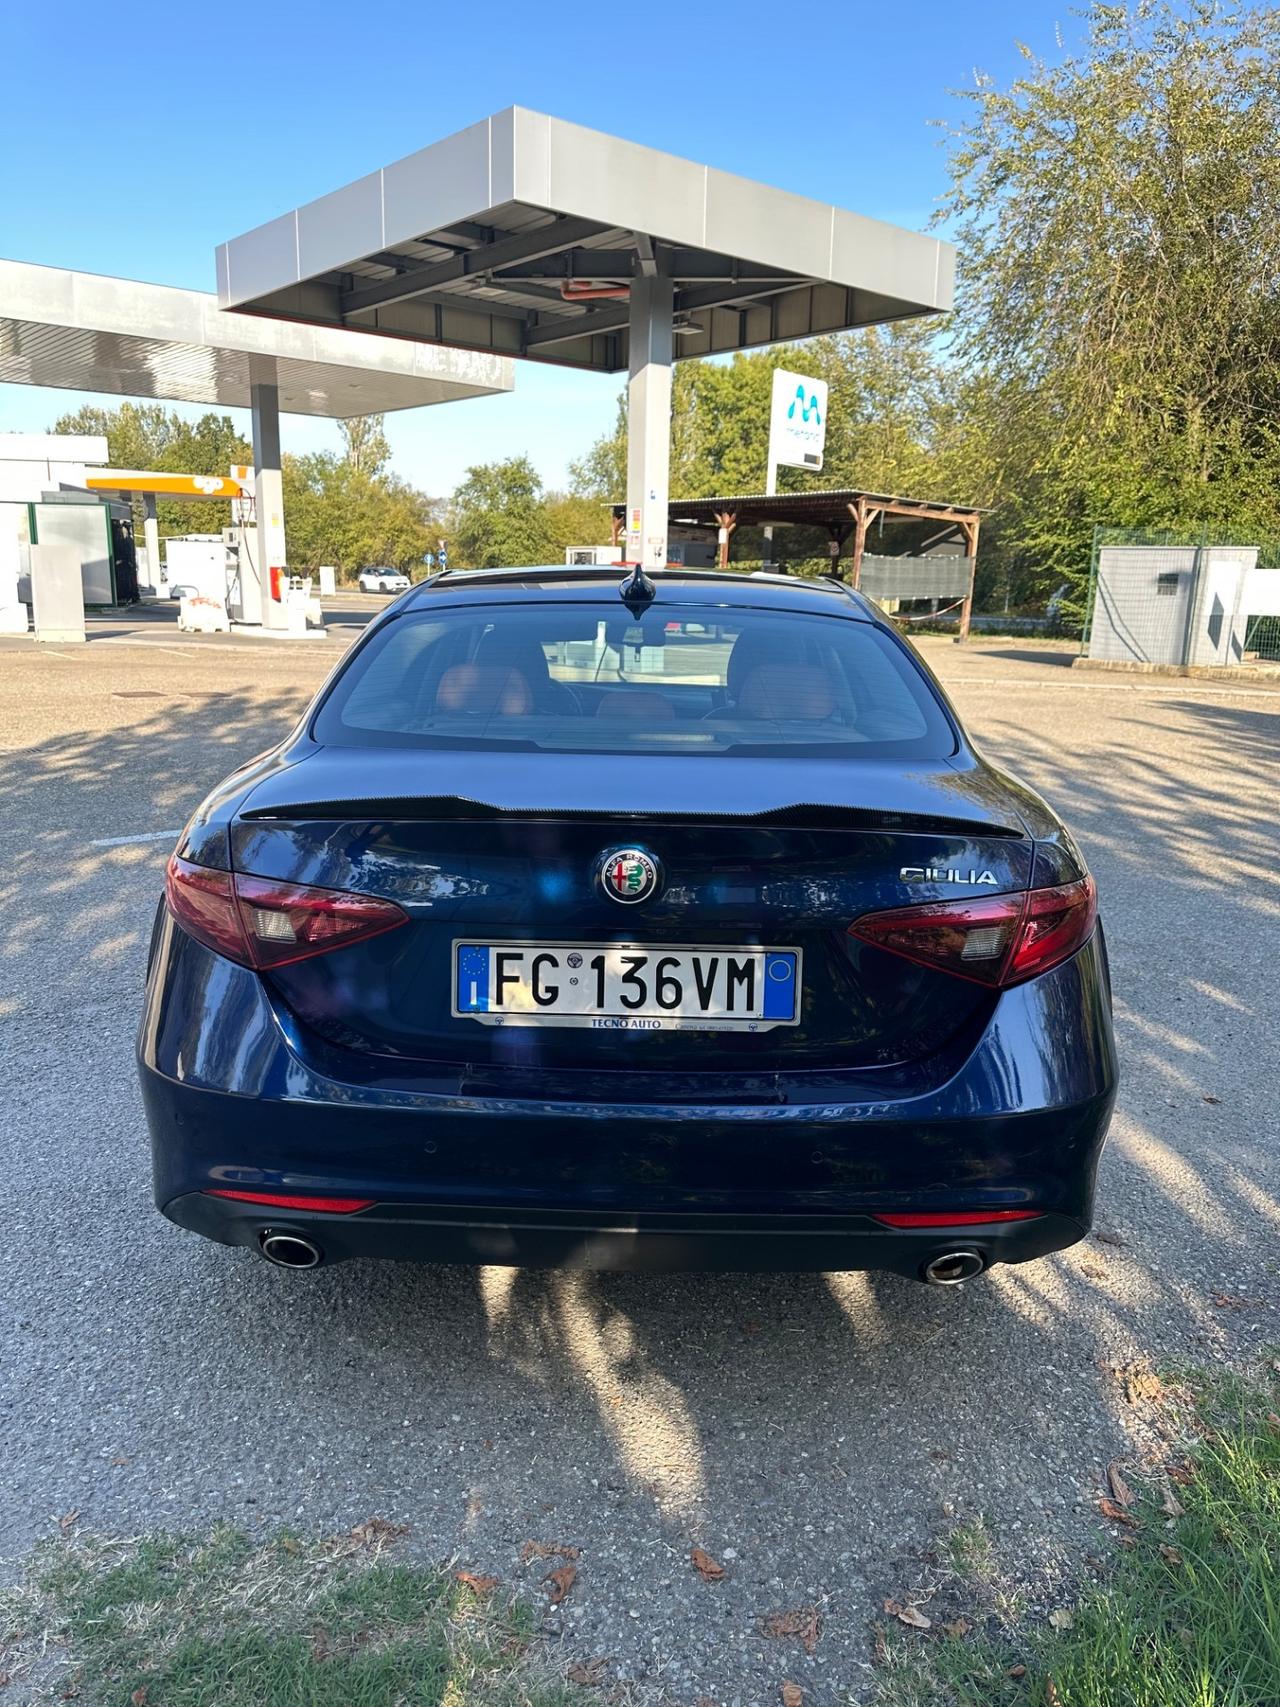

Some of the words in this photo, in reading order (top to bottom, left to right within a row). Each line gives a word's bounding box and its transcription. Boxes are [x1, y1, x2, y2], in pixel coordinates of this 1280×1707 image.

[606, 857, 623, 878] ALFA
[626, 854, 653, 879] ROMEO
[900, 867, 998, 885] GIULIA
[592, 1019, 628, 1029] TECNO
[631, 1020, 661, 1029] AUTO
